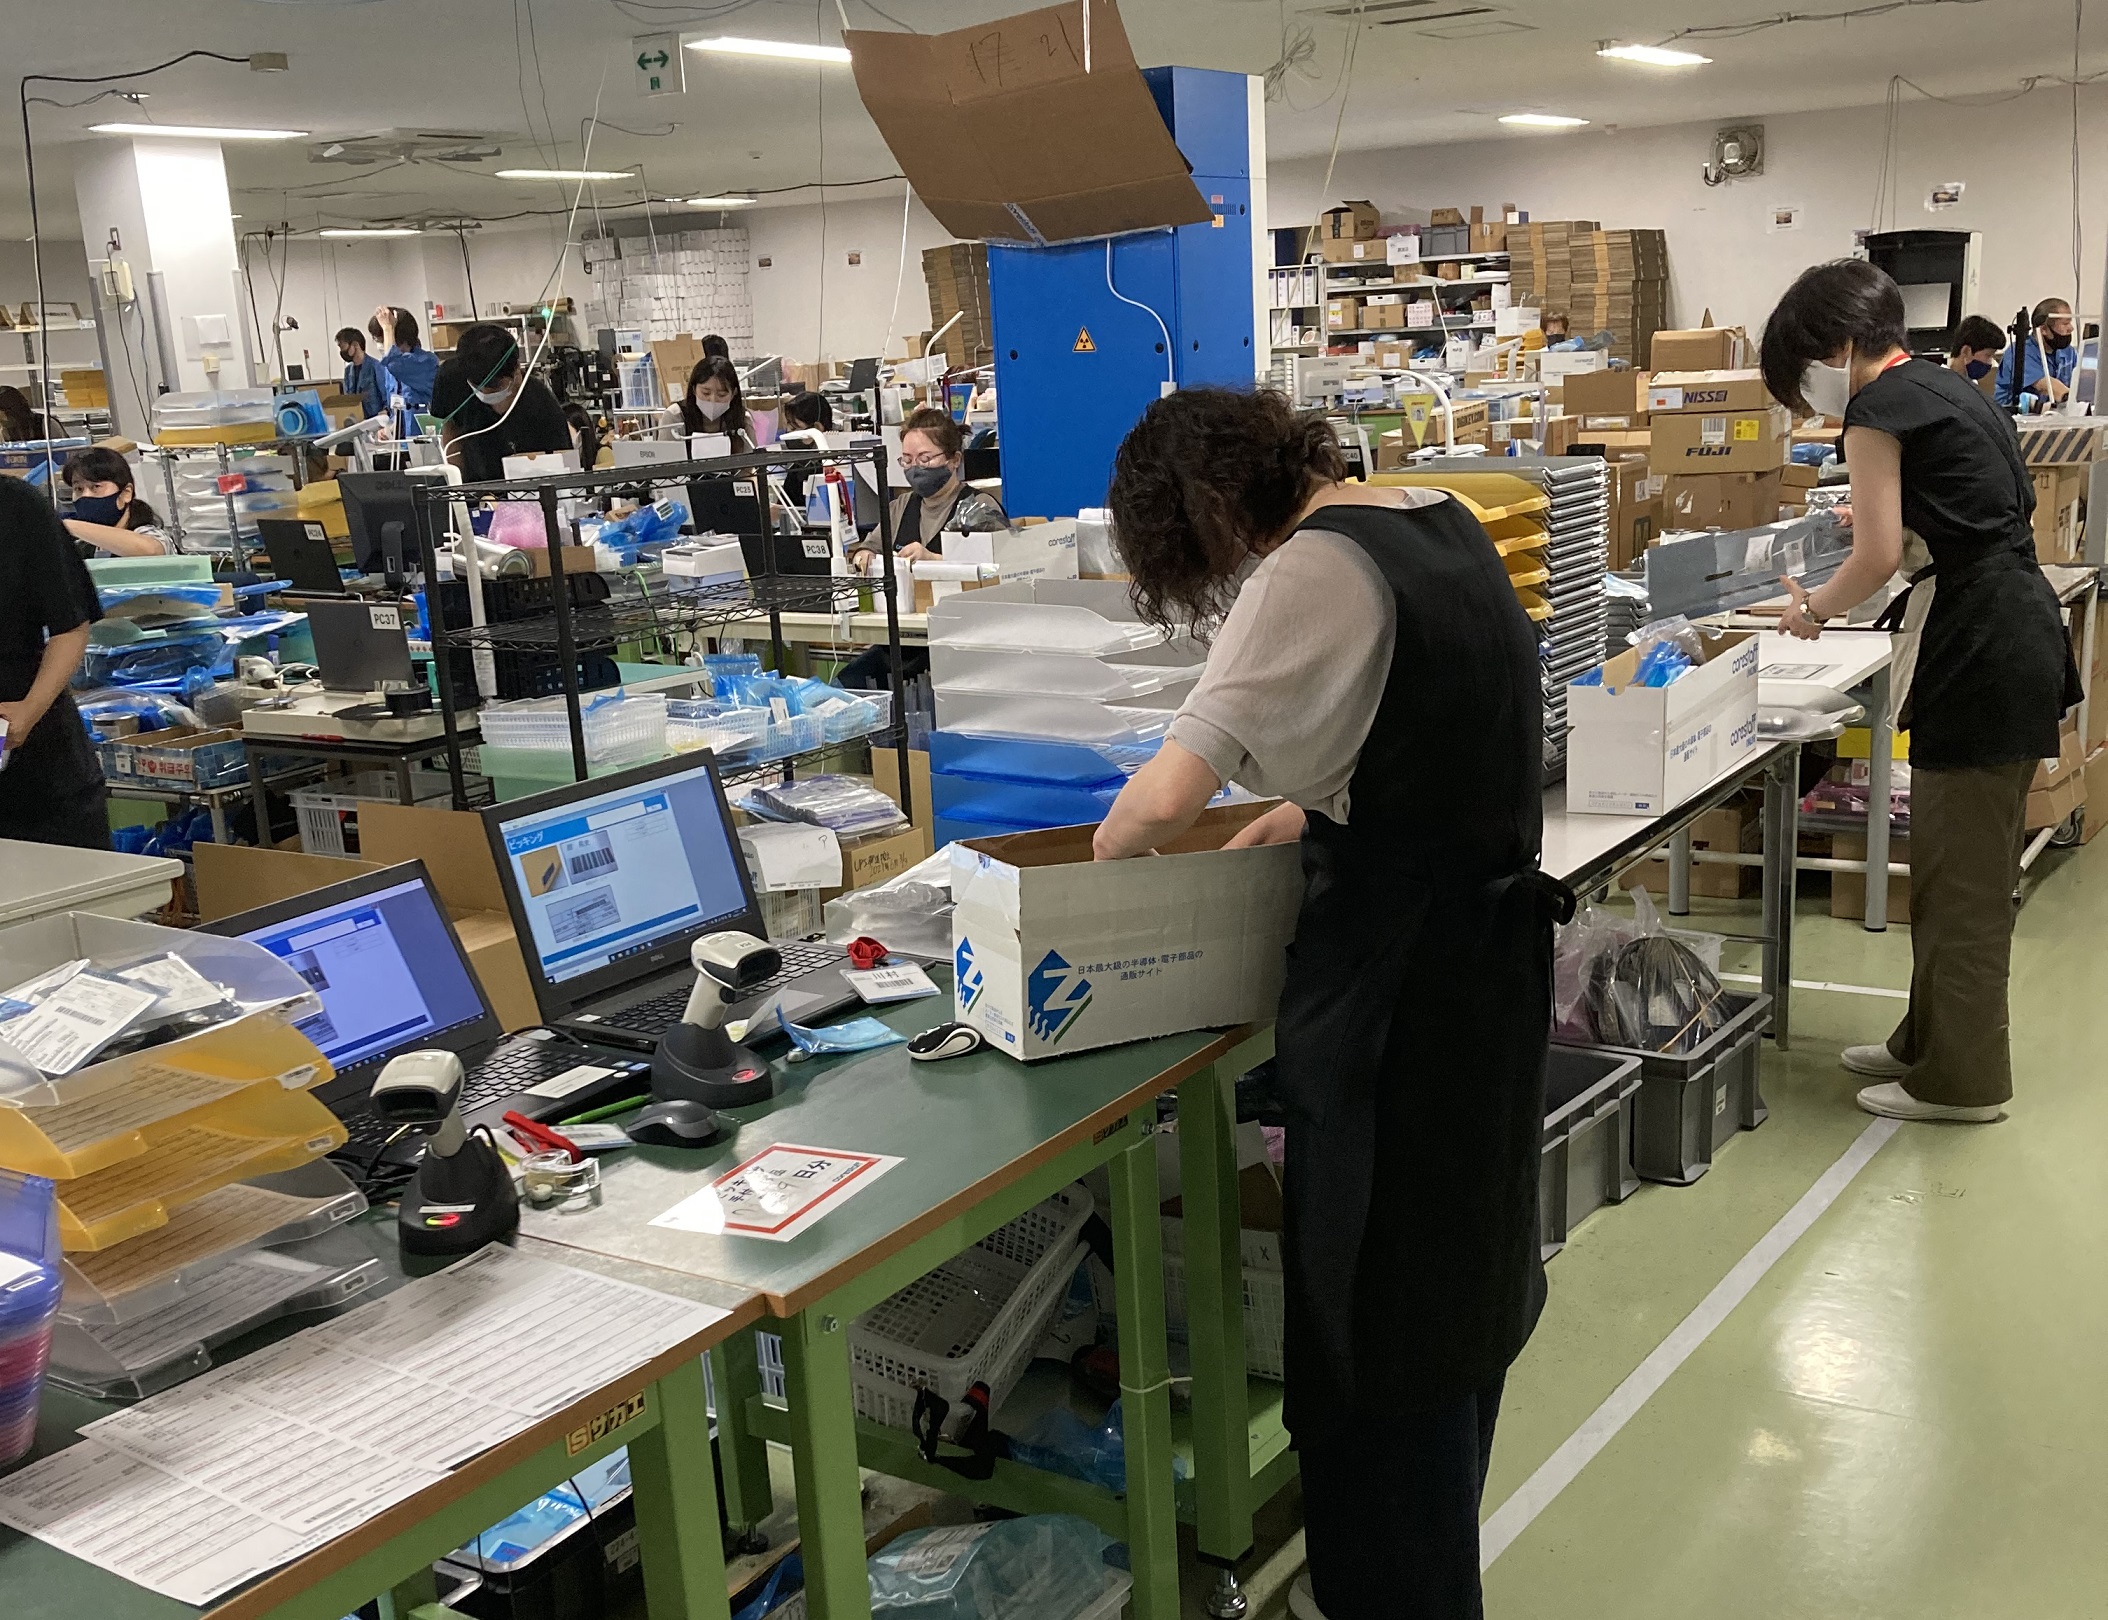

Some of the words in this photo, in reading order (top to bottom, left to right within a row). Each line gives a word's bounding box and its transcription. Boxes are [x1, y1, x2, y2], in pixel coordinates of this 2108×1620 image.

[1684, 390, 1728, 403] NISSEI
[1686, 446, 1732, 456] FUJI
[806, 545, 827, 554] PC38
[373, 613, 396, 625] PC37
[1732, 642, 1758, 673] corestaff
[1730, 713, 1757, 746] corestaff
[508, 830, 544, 850] ピッキング
[872, 970, 900, 980] 川村
[1120, 968, 1162, 981] 通販サイト
